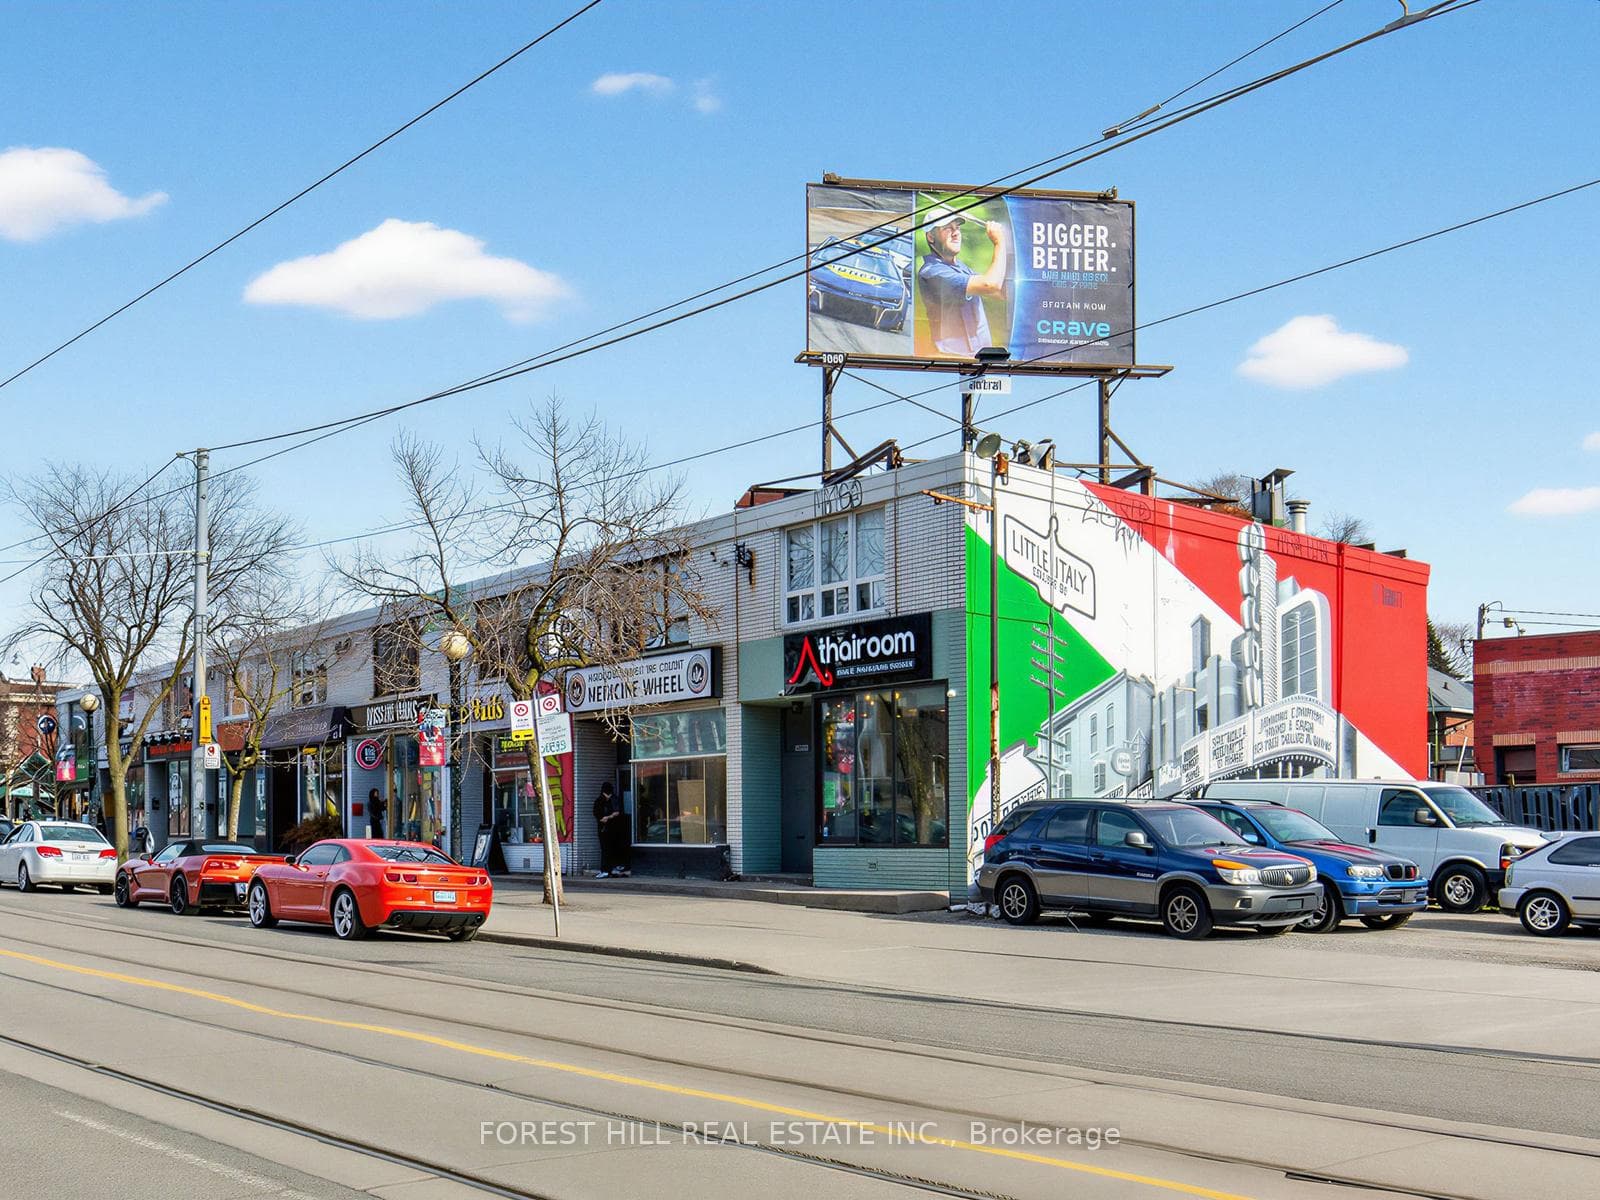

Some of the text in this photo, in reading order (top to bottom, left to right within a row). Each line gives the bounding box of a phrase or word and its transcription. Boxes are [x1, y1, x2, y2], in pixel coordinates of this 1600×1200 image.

[1032, 222, 1117, 248] BIGGER.
[1032, 246, 1117, 273] BETTER.
[1012, 529, 1049, 574] LITTLE
[1055, 556, 1087, 595] ITALY
[818, 630, 915, 664] thairoom
[643, 674, 684, 696] WHEEL
